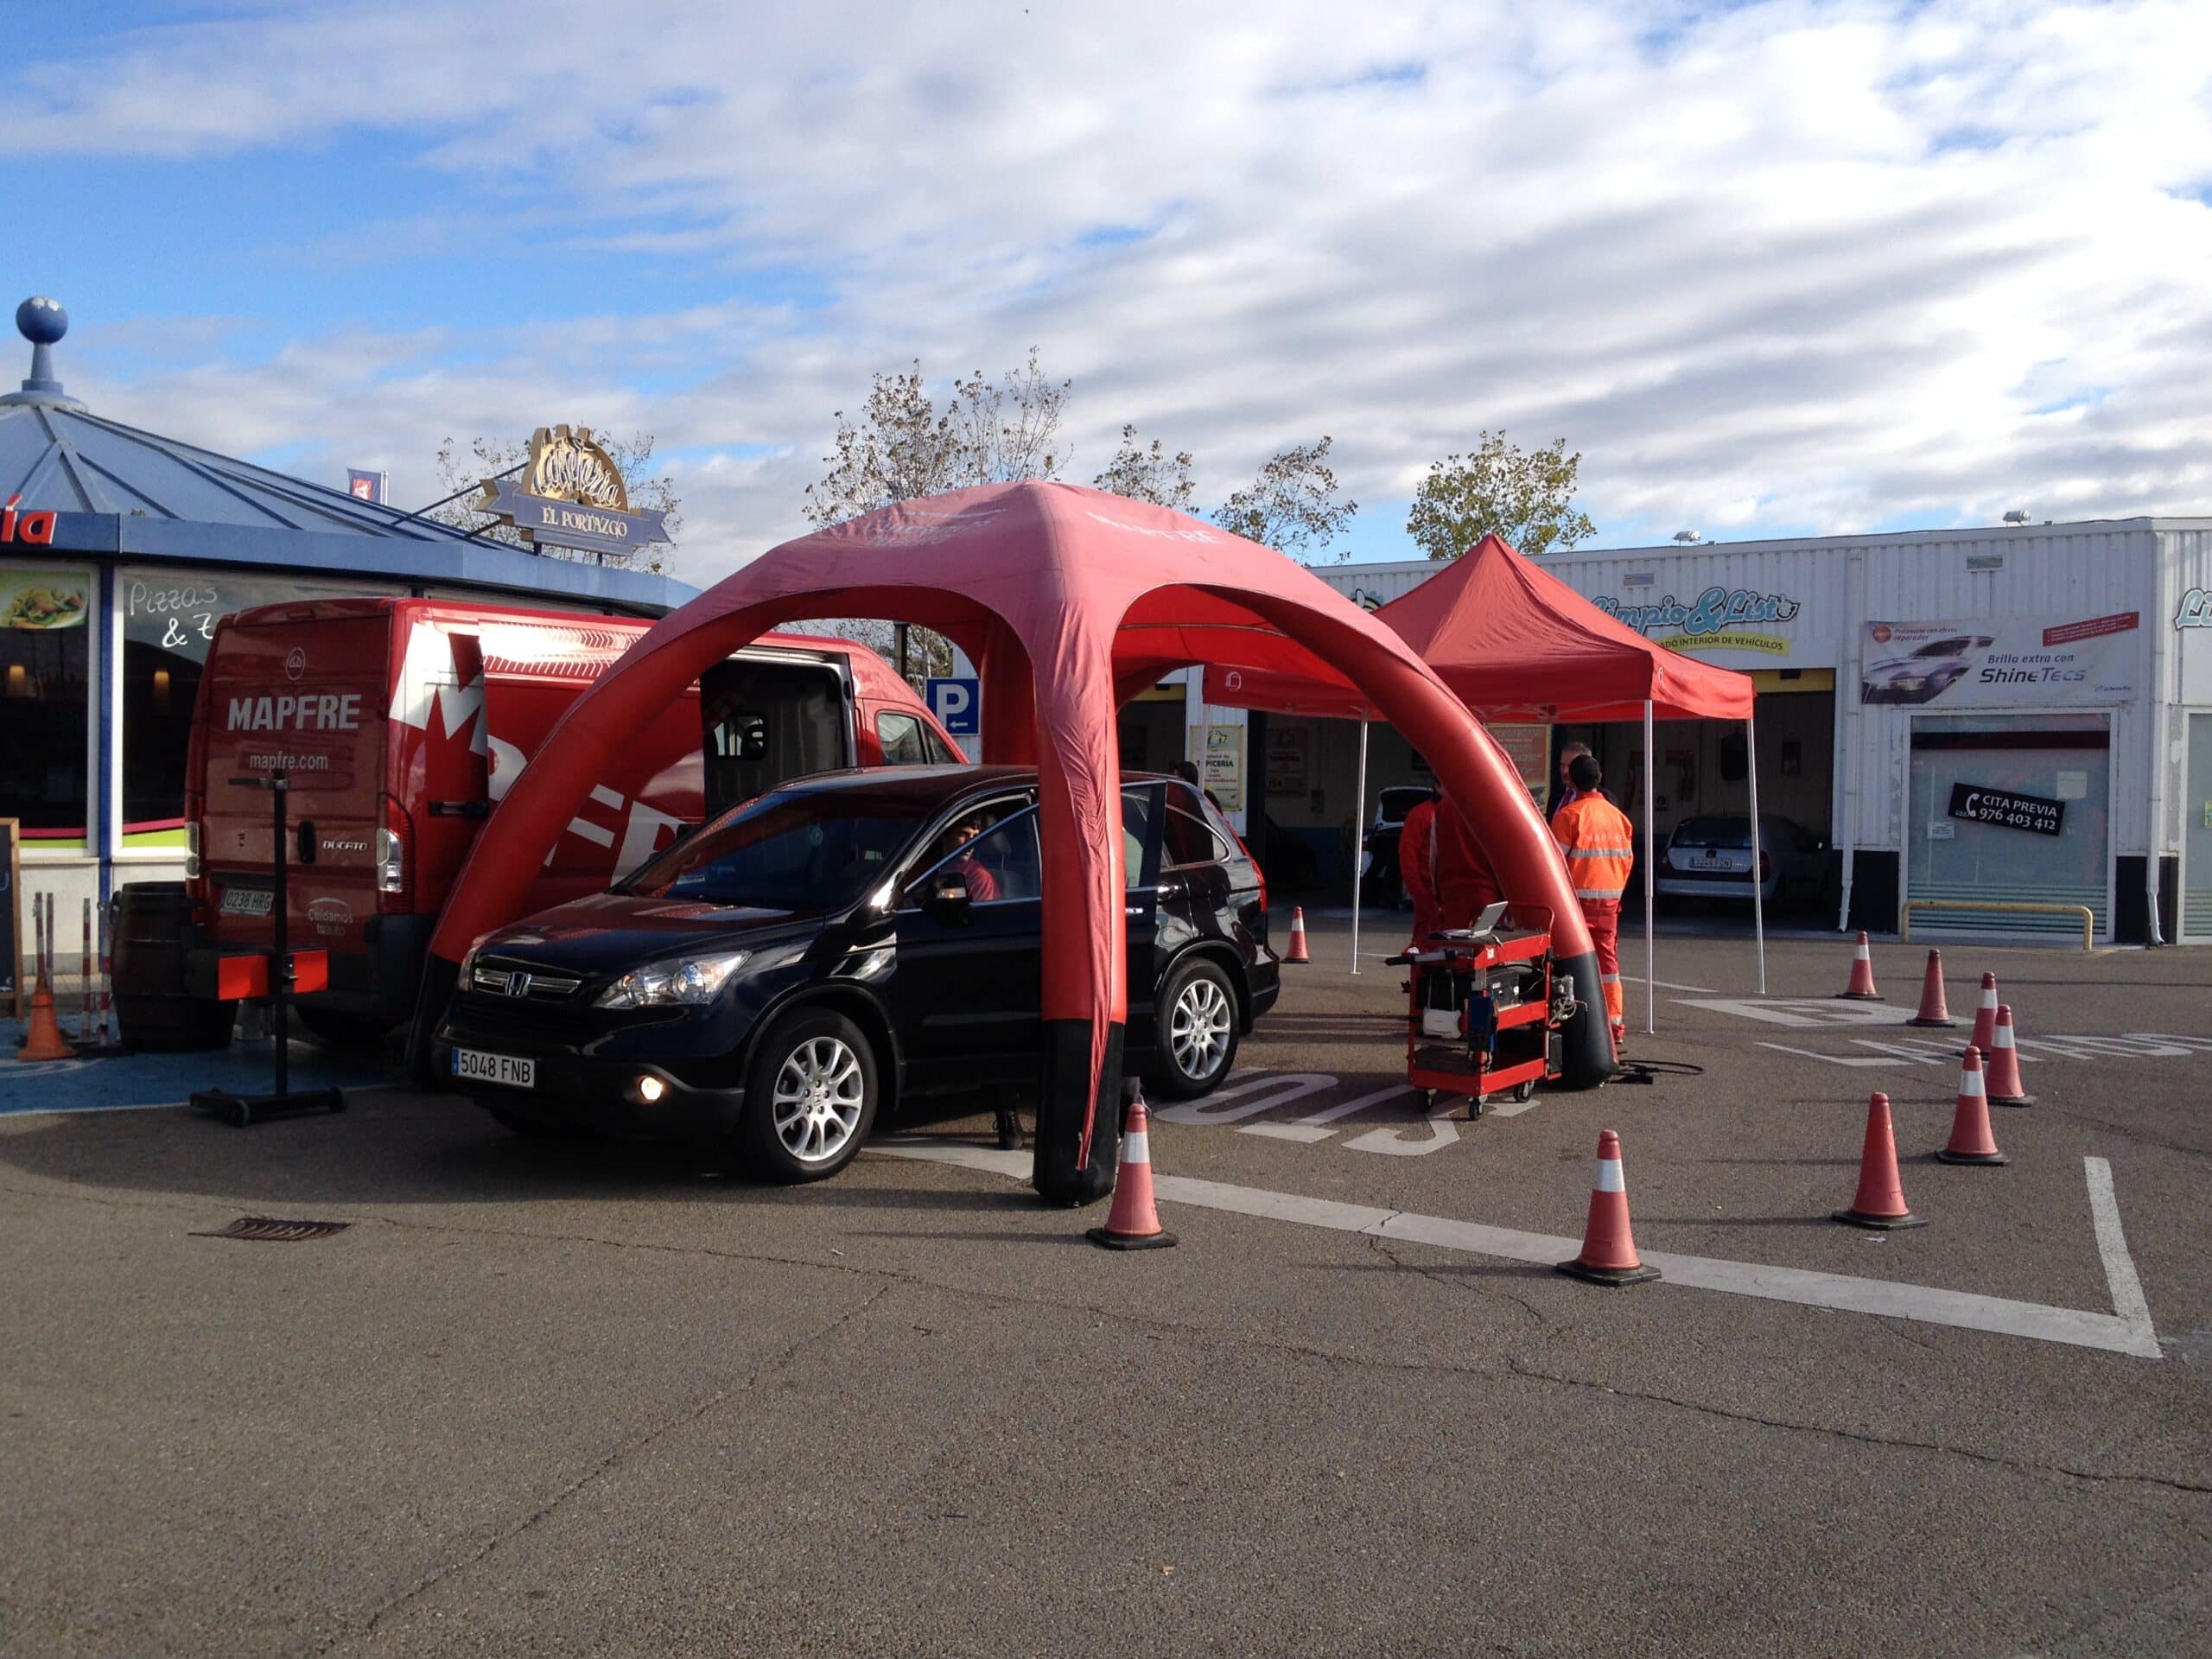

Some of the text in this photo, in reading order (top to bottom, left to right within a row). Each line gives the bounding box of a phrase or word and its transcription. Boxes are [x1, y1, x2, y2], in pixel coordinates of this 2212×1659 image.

[562, 511, 628, 539] PORTAZGO
[130, 582, 218, 616] Pizzas
[1685, 587, 1726, 635] &
[162, 617, 188, 648] &
[1680, 636, 1719, 646] INTERIOR
[1722, 636, 1732, 645] DE
[1735, 636, 1783, 650] VEHÍCULOS
[1988, 654, 2075, 664] Brillo extra con
[227, 694, 362, 731] MAPFRE
[937, 684, 969, 728] P
[250, 751, 328, 772] mapfre.com
[1982, 795, 2058, 817] CITA PREVIA
[1979, 808, 2004, 821] 976
[2006, 813, 2031, 828] 403
[2034, 818, 2056, 830] 412
[323, 840, 368, 851] DUCATO
[226, 891, 272, 910] 0238 HRG
[308, 908, 353, 924] Cuidamos
[461, 1052, 531, 1084] 5048 FNB
